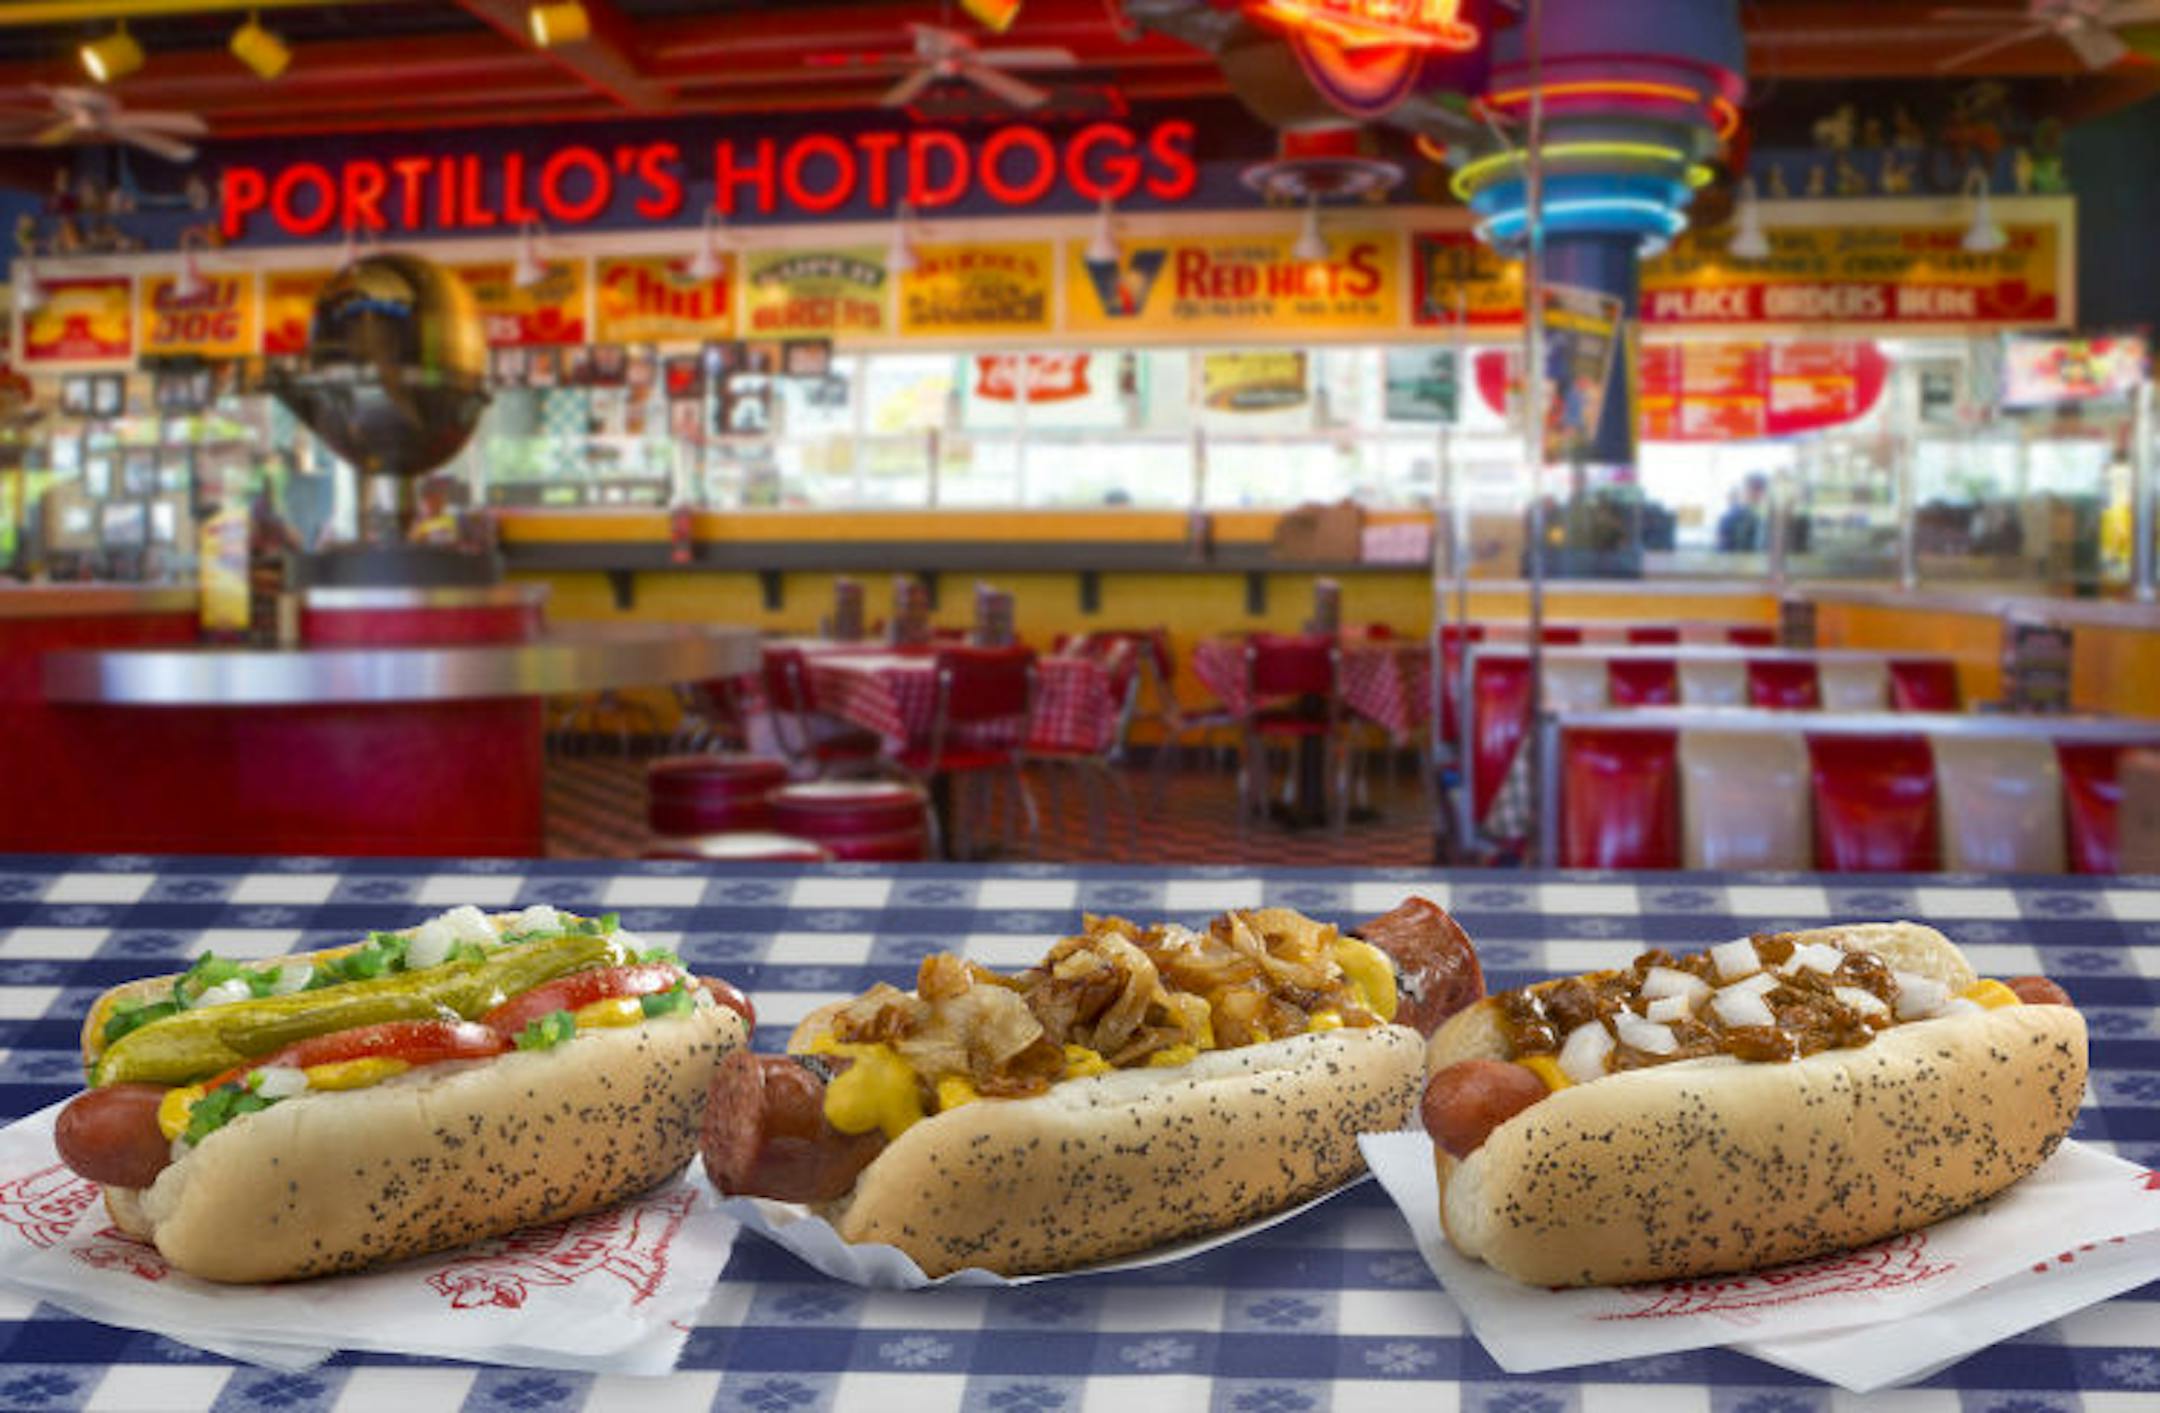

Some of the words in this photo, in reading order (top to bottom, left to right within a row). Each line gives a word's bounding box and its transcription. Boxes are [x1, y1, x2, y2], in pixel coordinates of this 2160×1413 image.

[221, 143, 684, 240] PORTILLO'S
[713, 119, 1198, 215] HOTDOGS
[1174, 246, 1257, 299] RED
[1653, 287, 1749, 317] PLACE
[1763, 284, 1888, 317] ORDERS
[1897, 285, 1980, 316] HERE
[151, 312, 241, 342] DOG
